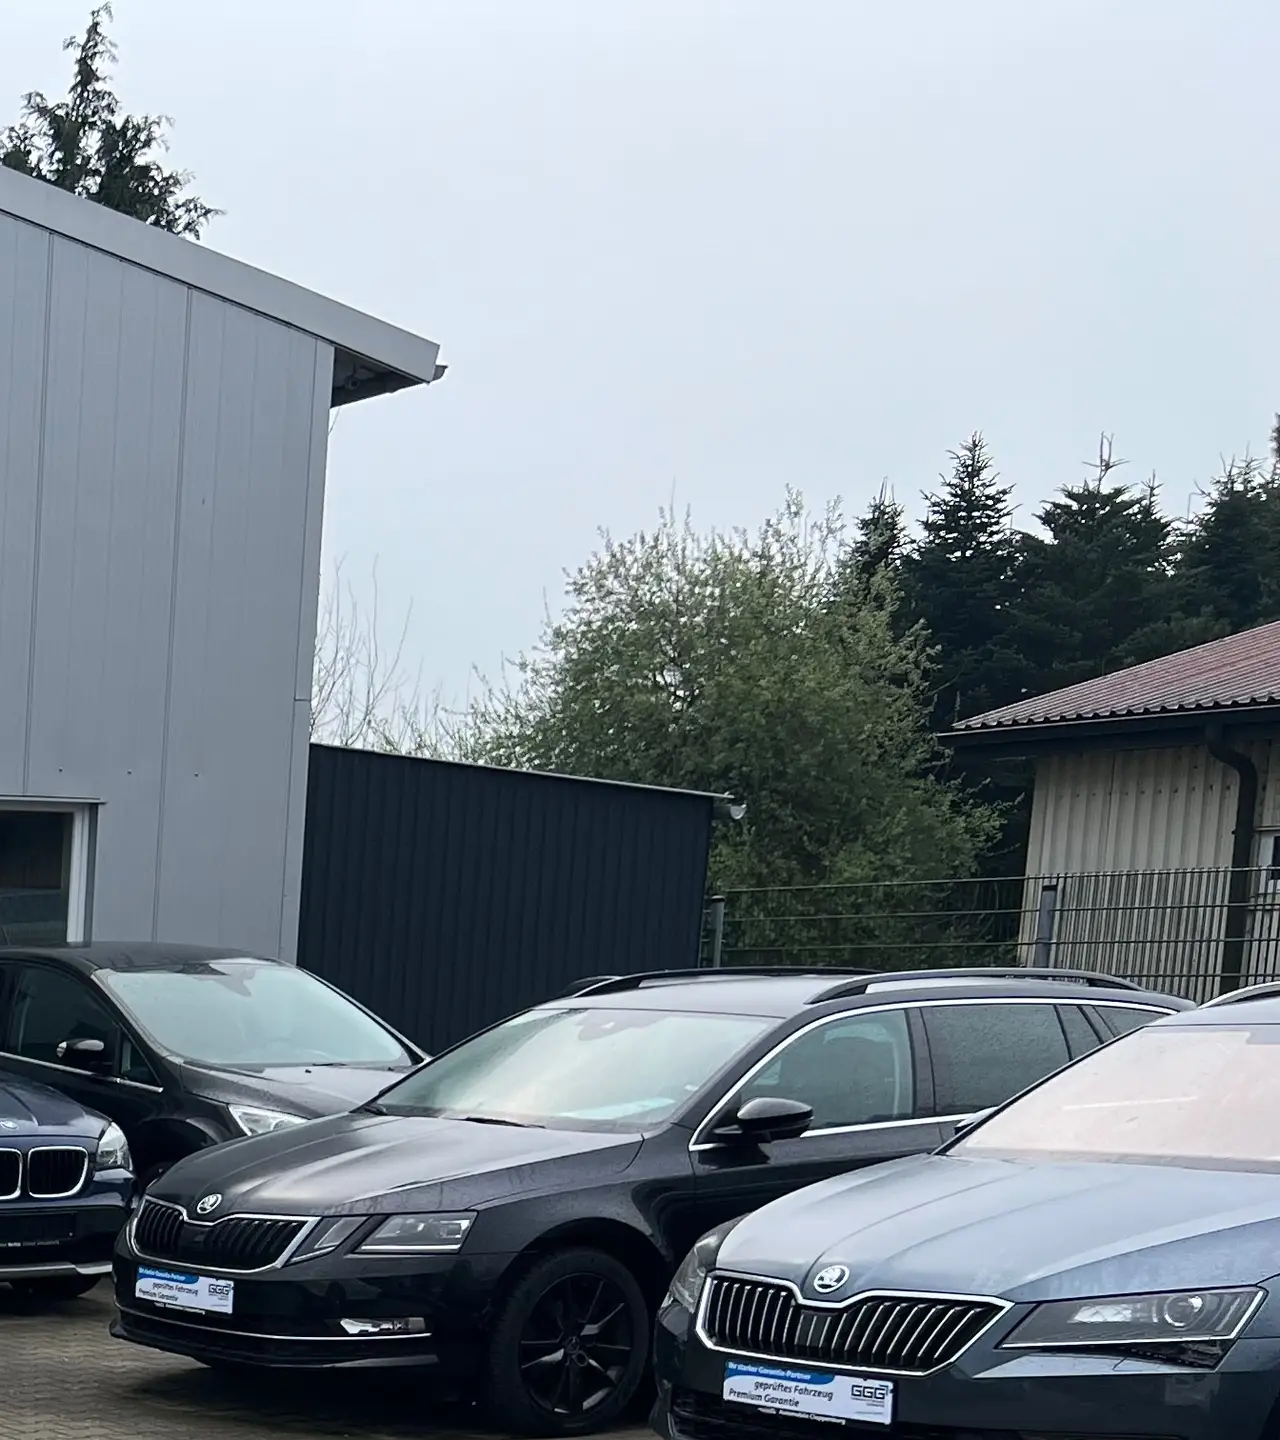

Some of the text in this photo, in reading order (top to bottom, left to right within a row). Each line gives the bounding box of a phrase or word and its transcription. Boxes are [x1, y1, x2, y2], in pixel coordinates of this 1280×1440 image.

[728, 1387, 800, 1407] Premium Garantie
[754, 1381, 834, 1401] geprüftes Fahrzeug
[851, 1384, 886, 1400] GGG
